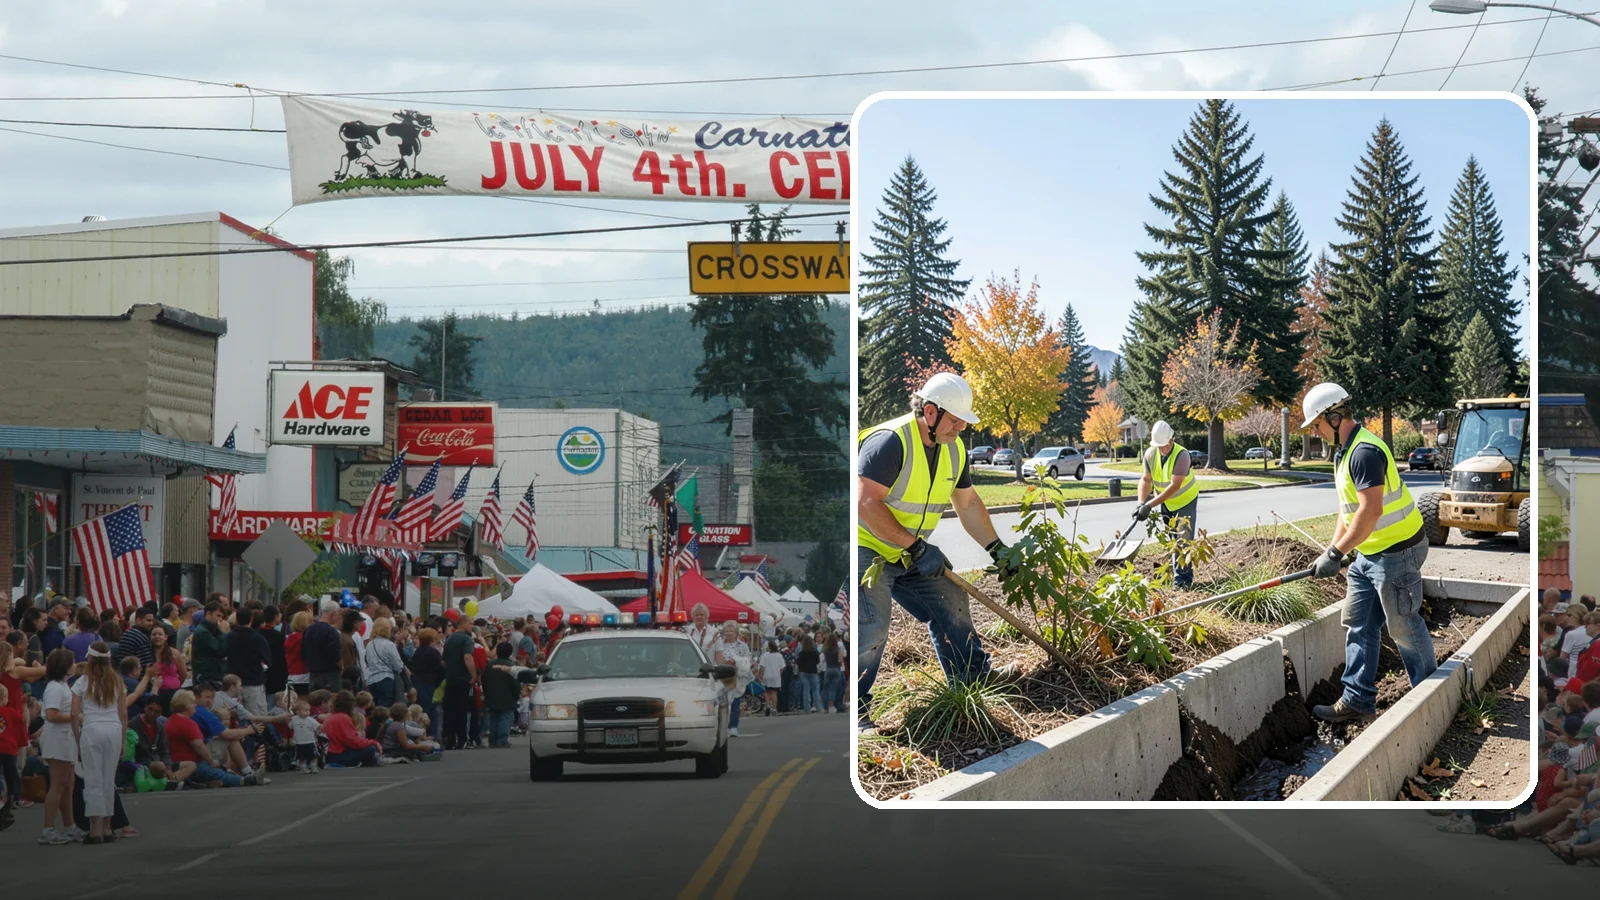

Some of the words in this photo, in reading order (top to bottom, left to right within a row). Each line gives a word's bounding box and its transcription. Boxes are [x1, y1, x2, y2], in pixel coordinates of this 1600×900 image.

[481, 141, 604, 193] JULY
[632, 148, 746, 198] 4th.
[697, 254, 850, 280] CROSSWA
[282, 380, 373, 420] ACE
[405, 409, 453, 422] CEDAR
[461, 409, 485, 422] LOG
[283, 421, 371, 437] Hardware
[416, 428, 477, 447] Coca-Cola
[353, 467, 384, 482] Simpl
[96, 485, 124, 495] Vincent
[126, 485, 136, 495] de
[137, 485, 155, 496] Paul
[688, 526, 741, 536] CRNATION
[700, 535, 730, 544] GLASS
